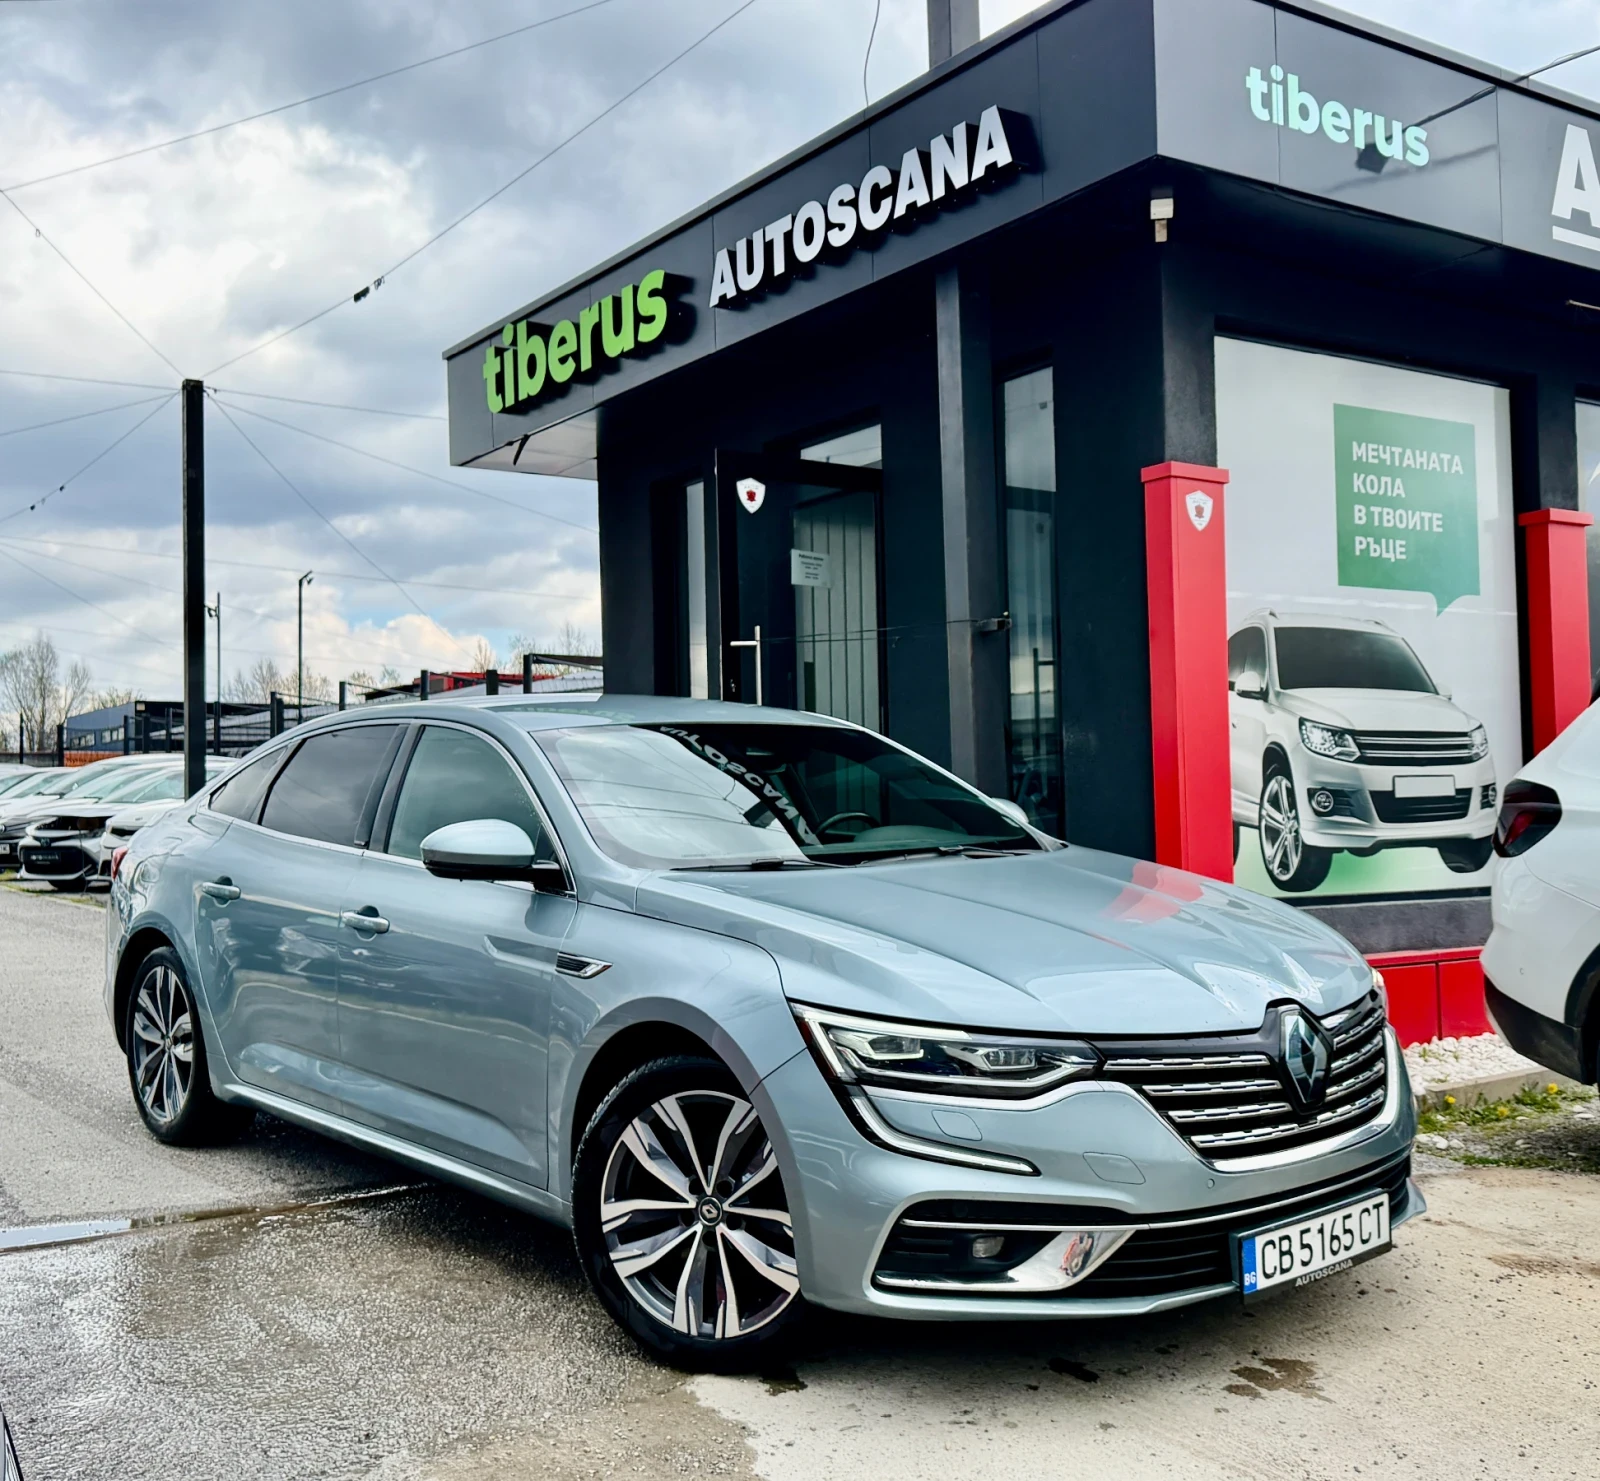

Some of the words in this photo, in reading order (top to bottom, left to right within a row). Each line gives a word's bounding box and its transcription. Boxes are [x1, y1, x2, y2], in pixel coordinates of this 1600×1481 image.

[1246, 64, 1430, 166] tiberus
[709, 104, 1012, 308] AUTOSCANA
[482, 269, 667, 415] tiberus
[1352, 440, 1464, 475] МЕЧТАНАТА
[1353, 472, 1406, 499] КОЛА
[1353, 504, 1367, 525] В
[1370, 505, 1444, 532] ТВОИТЕ
[1354, 536, 1407, 562] РЪЦЕ
[1243, 1271, 1257, 1287] BG
[1294, 1258, 1354, 1288] AUTOSCANA
